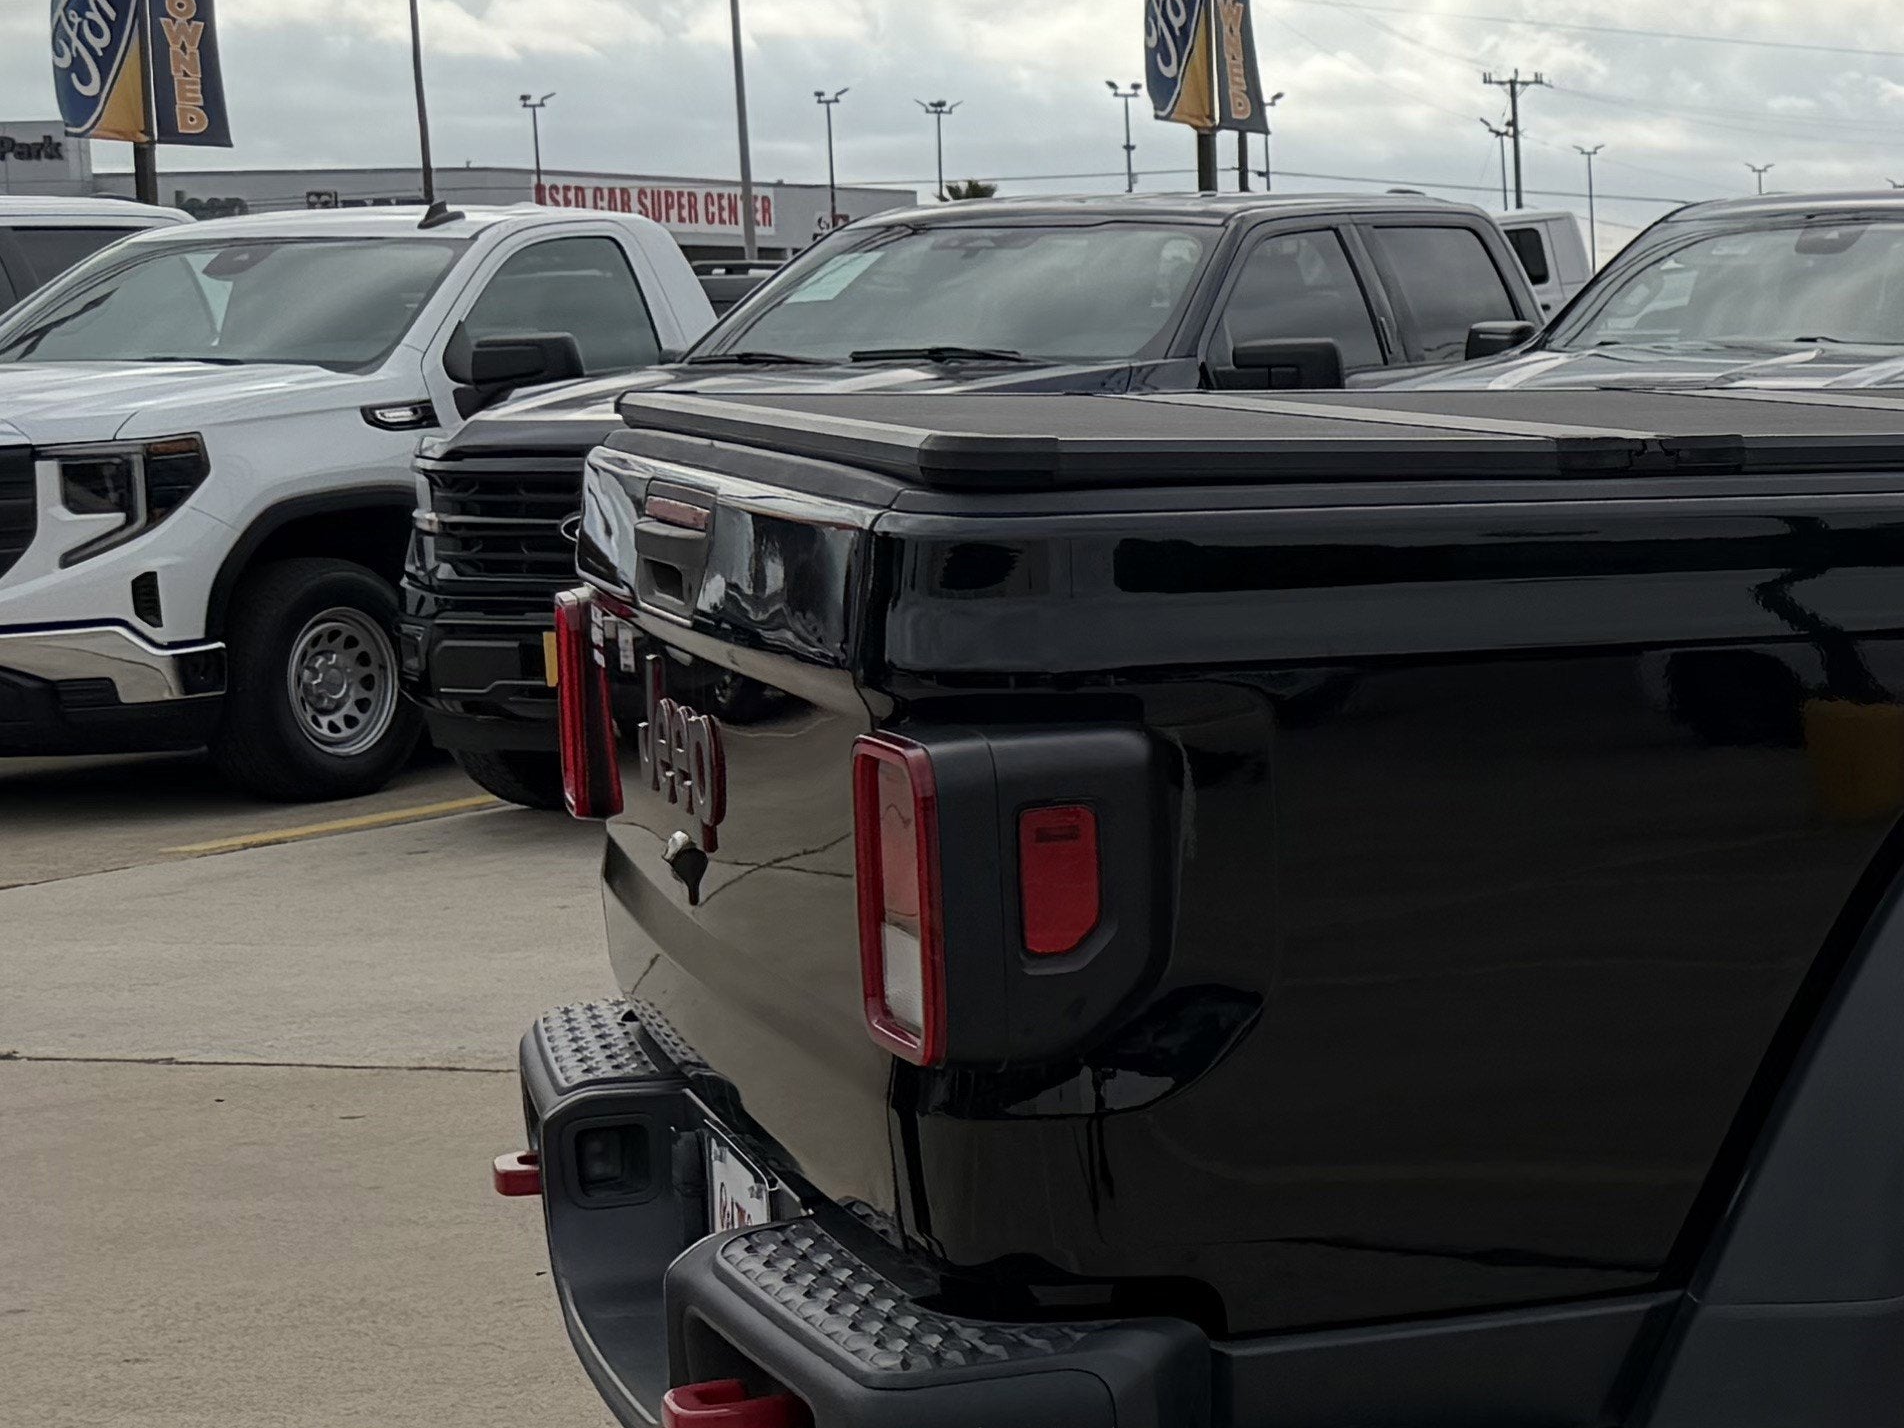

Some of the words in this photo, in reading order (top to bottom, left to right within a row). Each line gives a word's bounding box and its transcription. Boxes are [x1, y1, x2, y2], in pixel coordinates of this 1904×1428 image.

[535, 183, 587, 209] USED
[637, 188, 699, 224] SUPER
[704, 191, 773, 227] CENER
